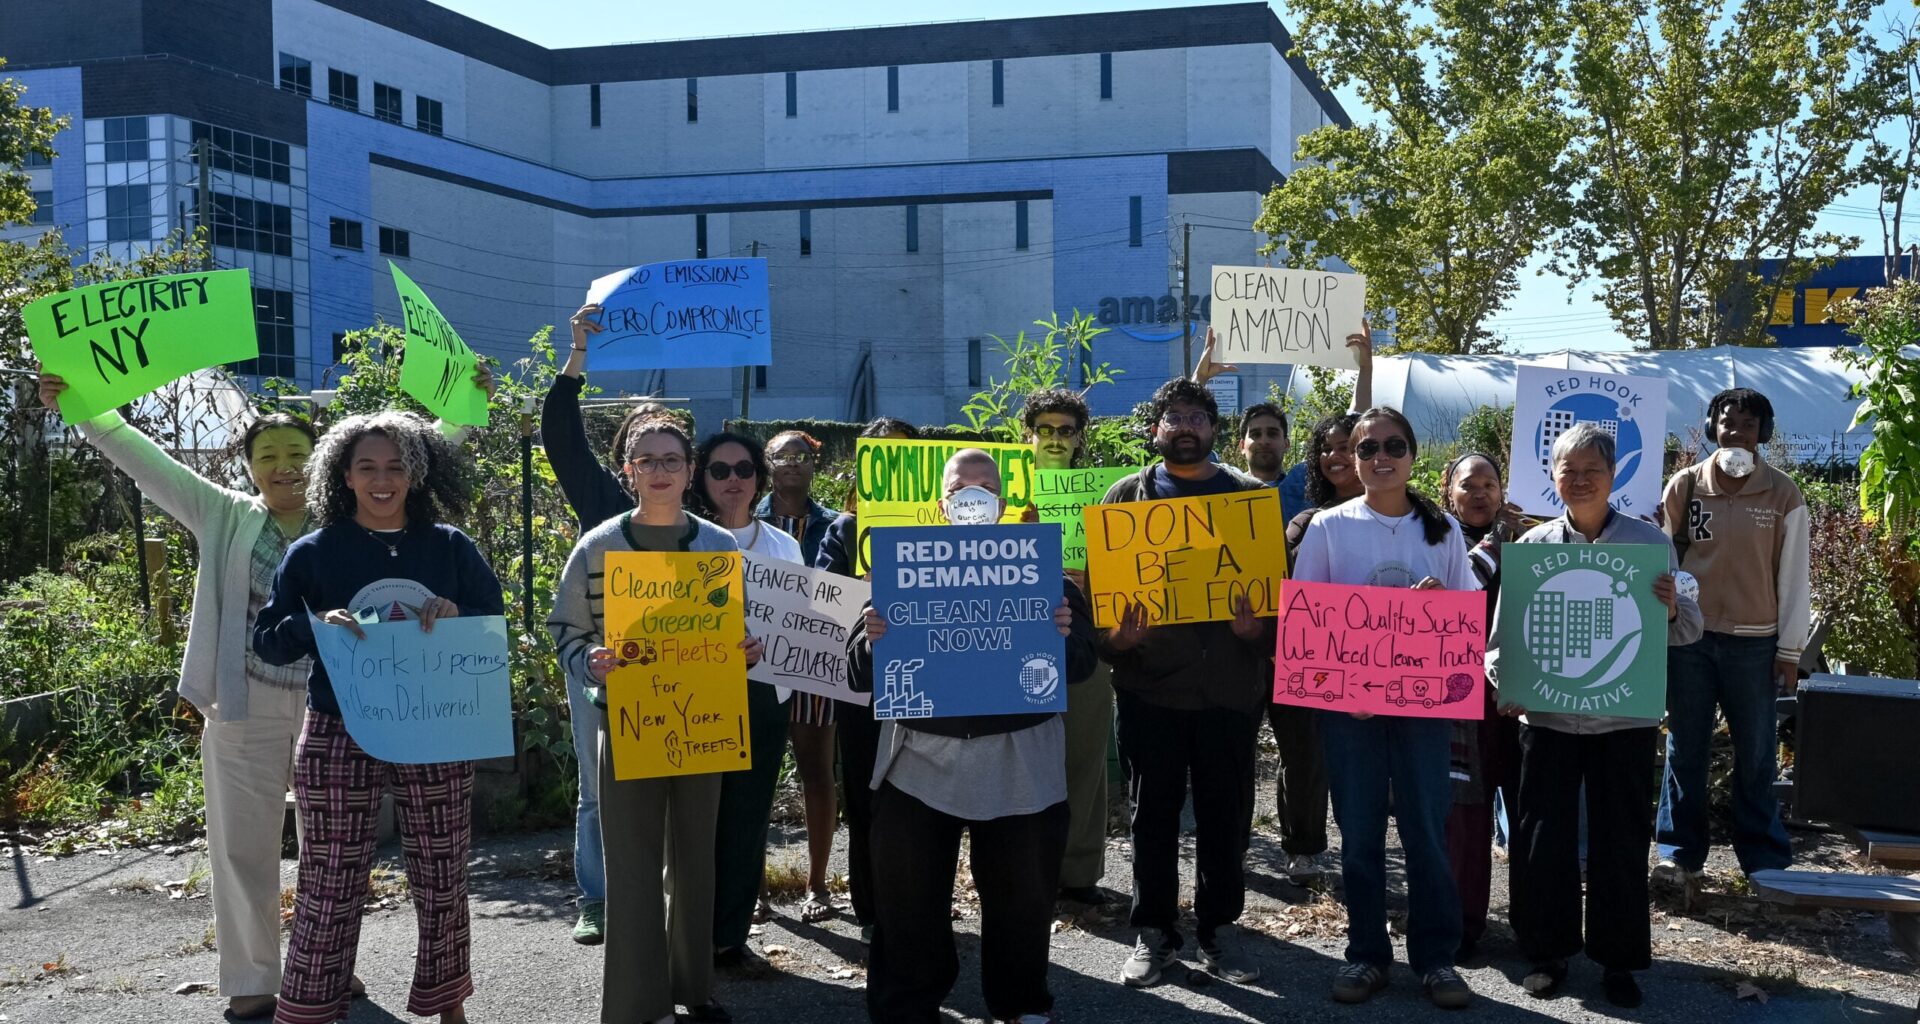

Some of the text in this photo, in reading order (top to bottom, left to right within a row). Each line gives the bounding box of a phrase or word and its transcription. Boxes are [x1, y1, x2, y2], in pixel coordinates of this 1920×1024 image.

[665, 265, 749, 283] EMISSIONS
[1214, 271, 1338, 308] CLEAN UP
[51, 276, 209, 338] ELECTRIFY
[650, 301, 767, 335] COMPROMISE
[1228, 308, 1331, 353] AMAZON
[89, 317, 150, 384] NY
[433, 357, 466, 407] NY
[1545, 376, 1643, 407] RED HOOK
[1102, 495, 1273, 551] DON'T
[1689, 498, 1713, 542] BK
[896, 541, 953, 562] RED
[959, 538, 1039, 561] HOOK
[1136, 543, 1243, 585] BE A
[1531, 549, 1640, 582] RED HOOK
[611, 566, 699, 603] Cleaner,
[897, 564, 1040, 589] DEMANDS
[814, 581, 842, 607] AIR
[641, 605, 729, 634] Greener
[781, 611, 847, 643] STREETS
[887, 597, 1050, 626] CLEAN AIR
[1284, 588, 1482, 636] Air Quality Sucks,
[341, 634, 410, 679] York
[422, 648, 443, 673] is
[661, 637, 728, 666] Fleets
[928, 626, 1012, 653] NOW!
[1282, 624, 1484, 669] We Need Cleaner Trucks
[396, 677, 481, 722] Deliveries!
[651, 674, 683, 698] for
[1533, 679, 1633, 711] INITIATIVE
